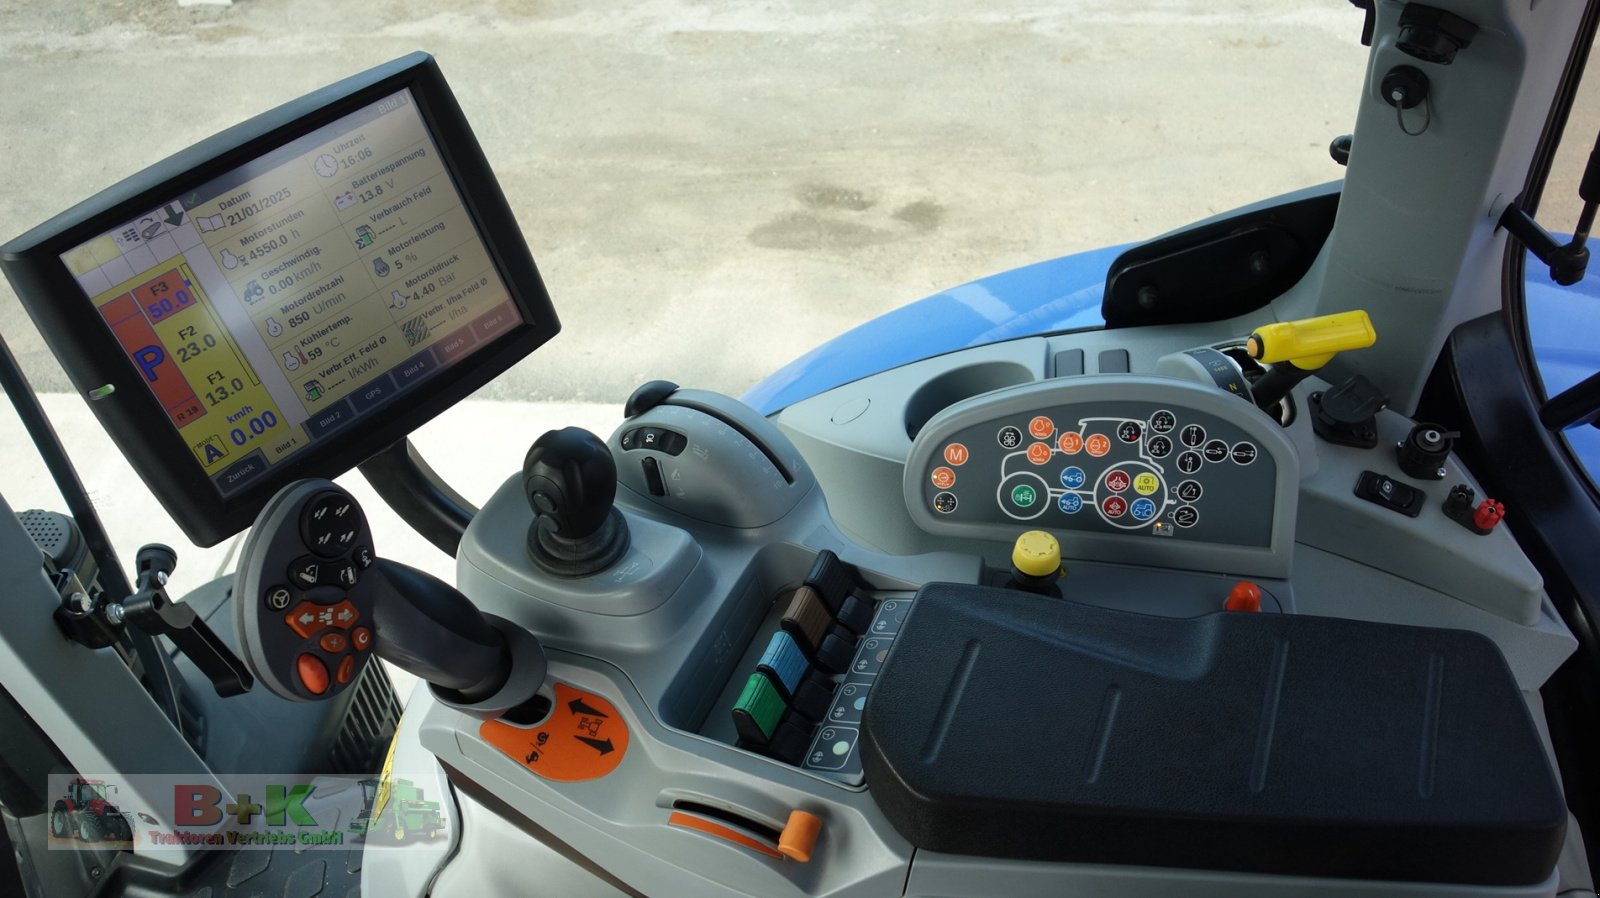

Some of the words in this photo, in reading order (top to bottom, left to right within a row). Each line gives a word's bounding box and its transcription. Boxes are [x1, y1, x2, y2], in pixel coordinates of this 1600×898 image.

[378, 98, 398, 114] Bild
[333, 133, 366, 154] Uhrzeit
[341, 146, 373, 169] 16:06
[351, 147, 426, 189] Batteriespannung
[218, 190, 251, 211] Datum
[359, 184, 383, 204] 13.8
[384, 177, 394, 189] V
[227, 187, 291, 226] 21/01/2025
[370, 196, 413, 222] Verbrauch
[413, 185, 432, 200] Feld
[239, 209, 304, 246] Motorstunden
[387, 221, 445, 256] Motorleistung
[250, 233, 288, 259] 4550.0
[289, 228, 300, 239] h
[261, 246, 322, 280] Geschwindig.
[393, 258, 403, 270] 5
[150, 280, 169, 296] F3
[268, 275, 294, 295] 0.00
[292, 261, 322, 282] km/h
[413, 282, 436, 300] 4.40
[438, 271, 456, 287] Bar
[147, 289, 189, 319] 50.0
[280, 274, 344, 315] Motordrehzahl
[421, 303, 443, 319] Verbr.
[462, 281, 480, 296] Feld
[288, 310, 310, 328] 850
[312, 292, 346, 314] U/min
[178, 325, 197, 341] F2
[176, 333, 216, 363] 23.0
[307, 346, 322, 360] 59
[325, 336, 341, 348] °C
[359, 339, 378, 356] Feld
[132, 344, 165, 383] P
[404, 364, 419, 377] Bild
[207, 369, 225, 385] F1
[205, 377, 244, 407] 13.0
[365, 386, 382, 400] GPS
[176, 412, 186, 421] R
[226, 405, 253, 424] km/h
[319, 414, 335, 428] Bild
[230, 410, 277, 446] 0.00
[199, 440, 224, 463] A
[275, 440, 291, 454] Bild
[949, 449, 963, 462] M
